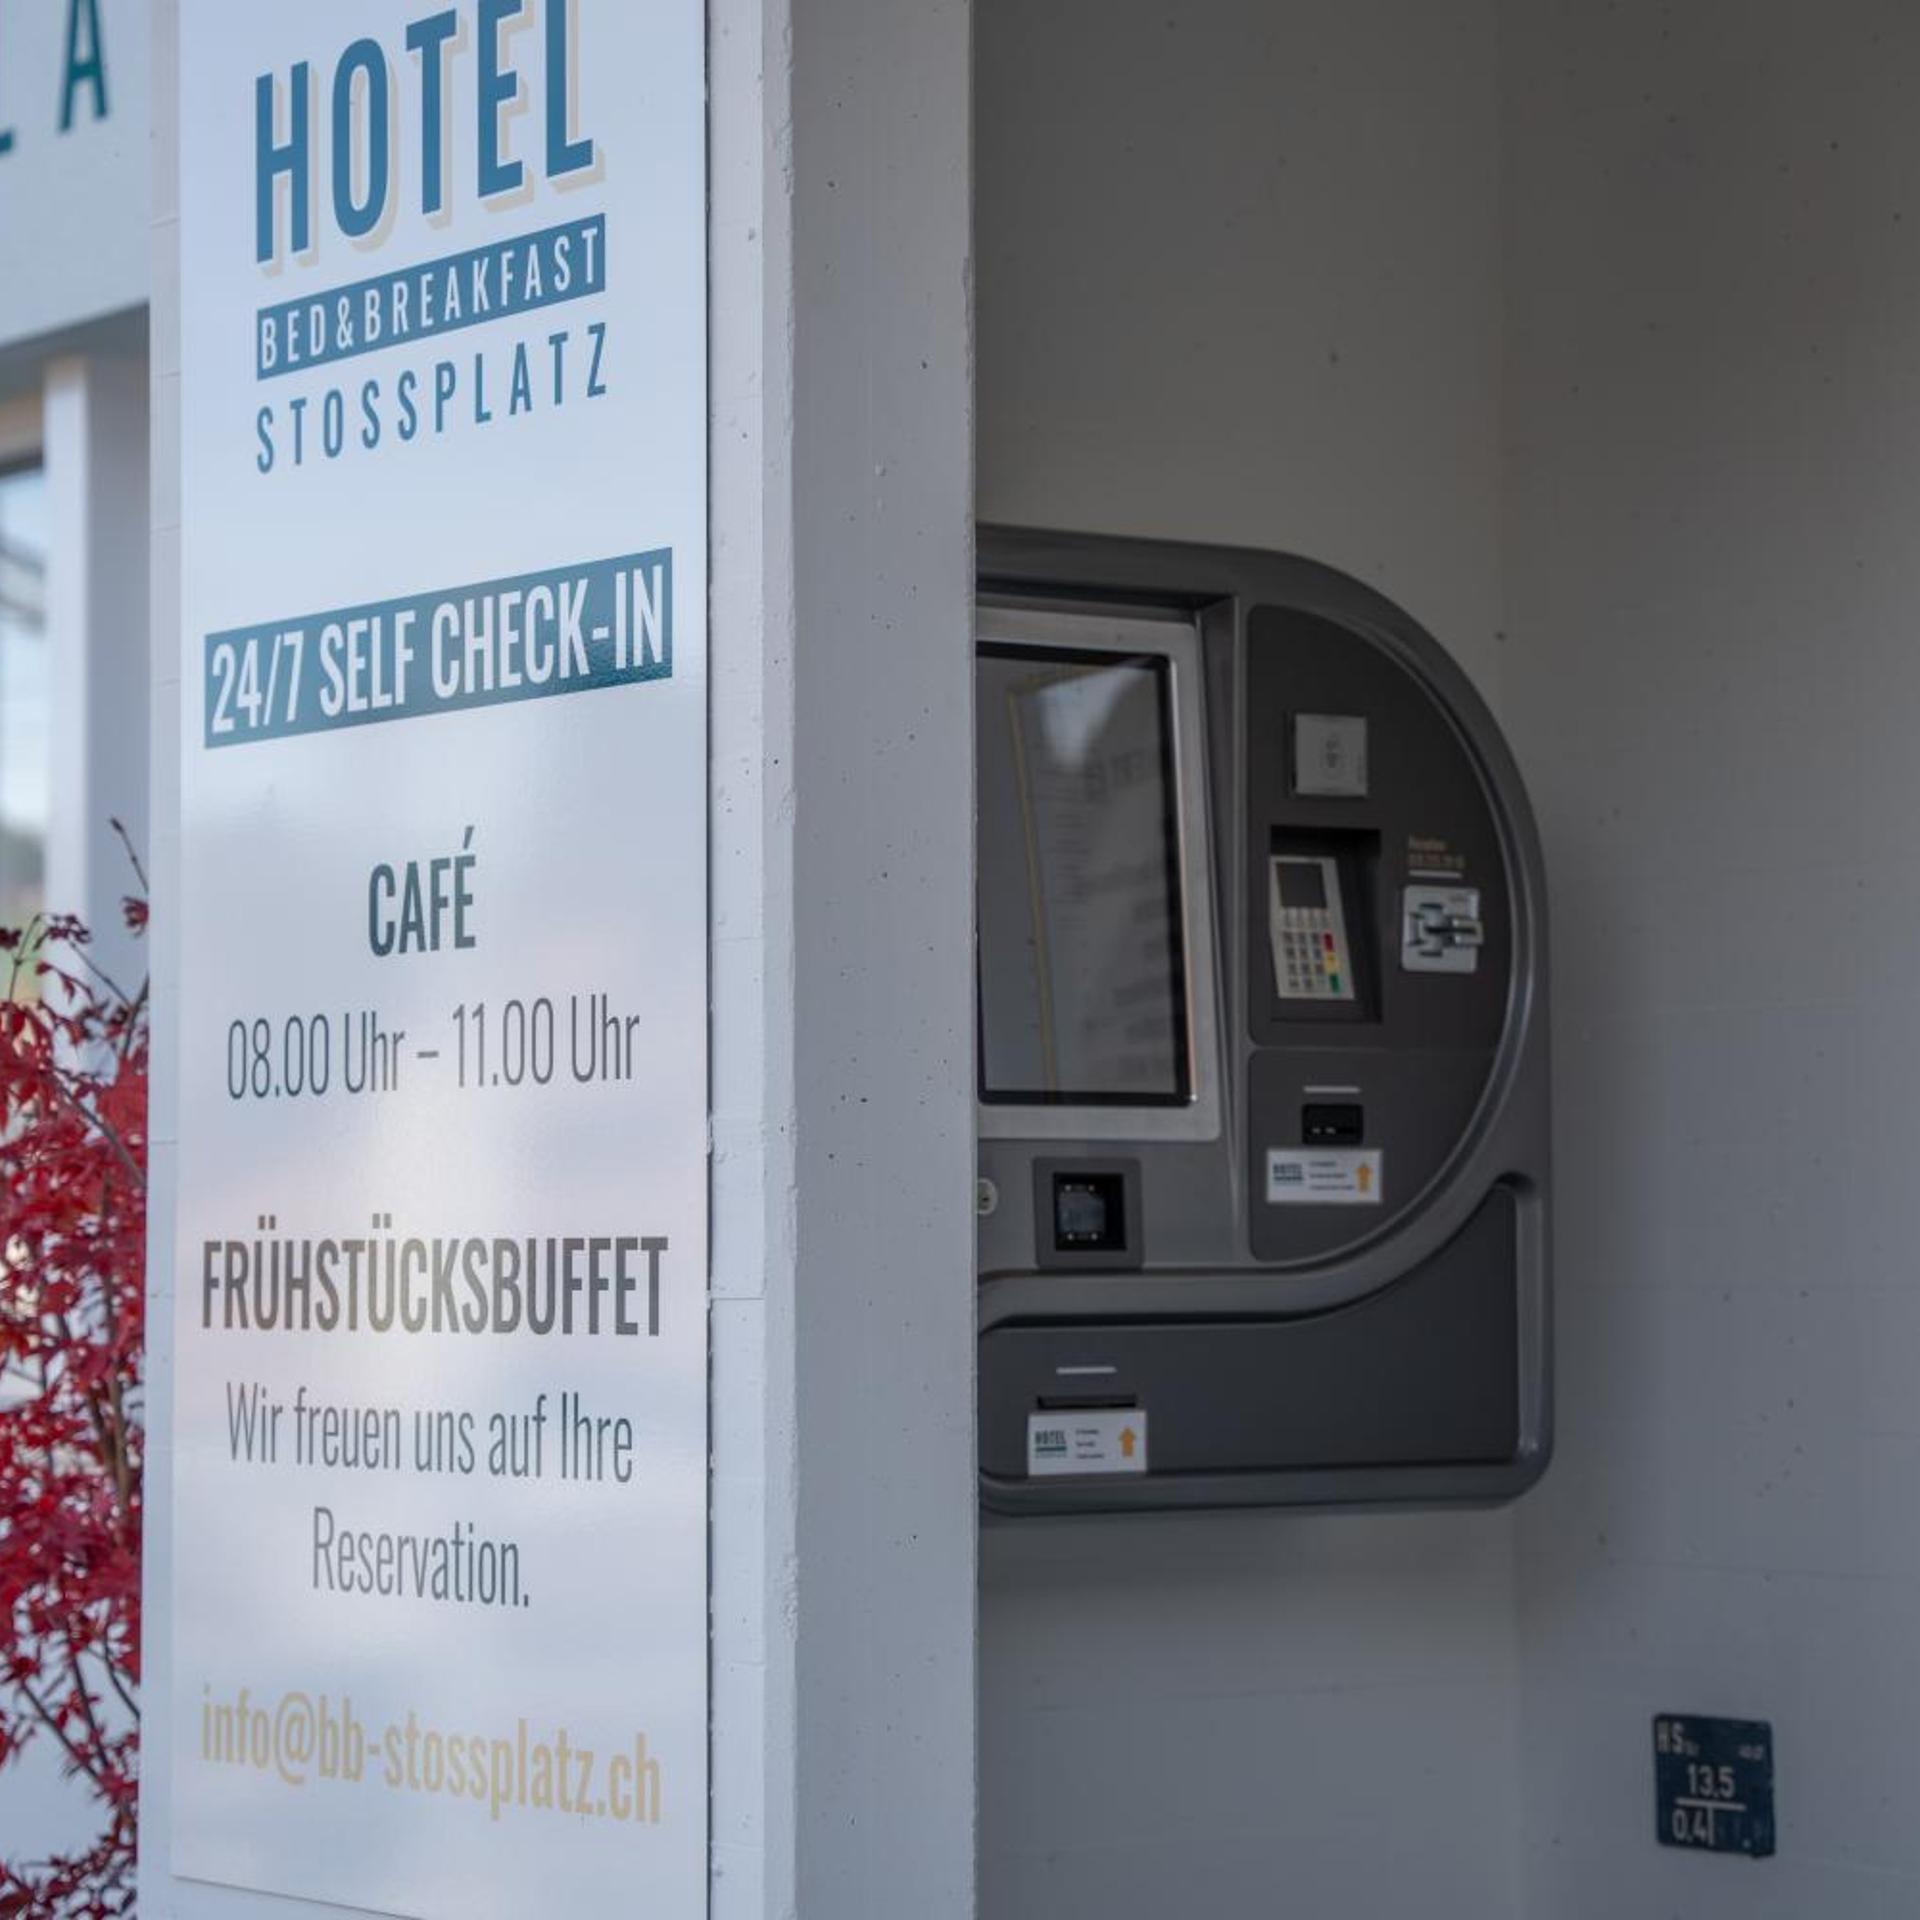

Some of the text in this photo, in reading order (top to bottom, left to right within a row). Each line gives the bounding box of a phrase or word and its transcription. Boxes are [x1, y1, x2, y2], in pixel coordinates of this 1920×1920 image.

[255, 0, 597, 266] HOTEL
[260, 226, 601, 371] BED&BREAKFAST
[256, 321, 607, 474] STOSSPLATZ
[211, 564, 664, 735] 24/7 SELF CHECK-IN
[367, 825, 477, 957] CAFÉ
[226, 1013, 330, 1100] 08.00
[344, 1010, 405, 1094] Uhr
[452, 997, 555, 1088] 11.00
[571, 993, 641, 1083] Uhr
[202, 1213, 669, 1336] FRÜHSTÜCKSBUFFET
[226, 1381, 633, 1483] Wir freuen uns auf Ihre
[312, 1506, 530, 1608] Reservation.
[202, 1683, 661, 1824] info@bb-stossplatz.ch
[1687, 1763, 1736, 1798] 13.5
